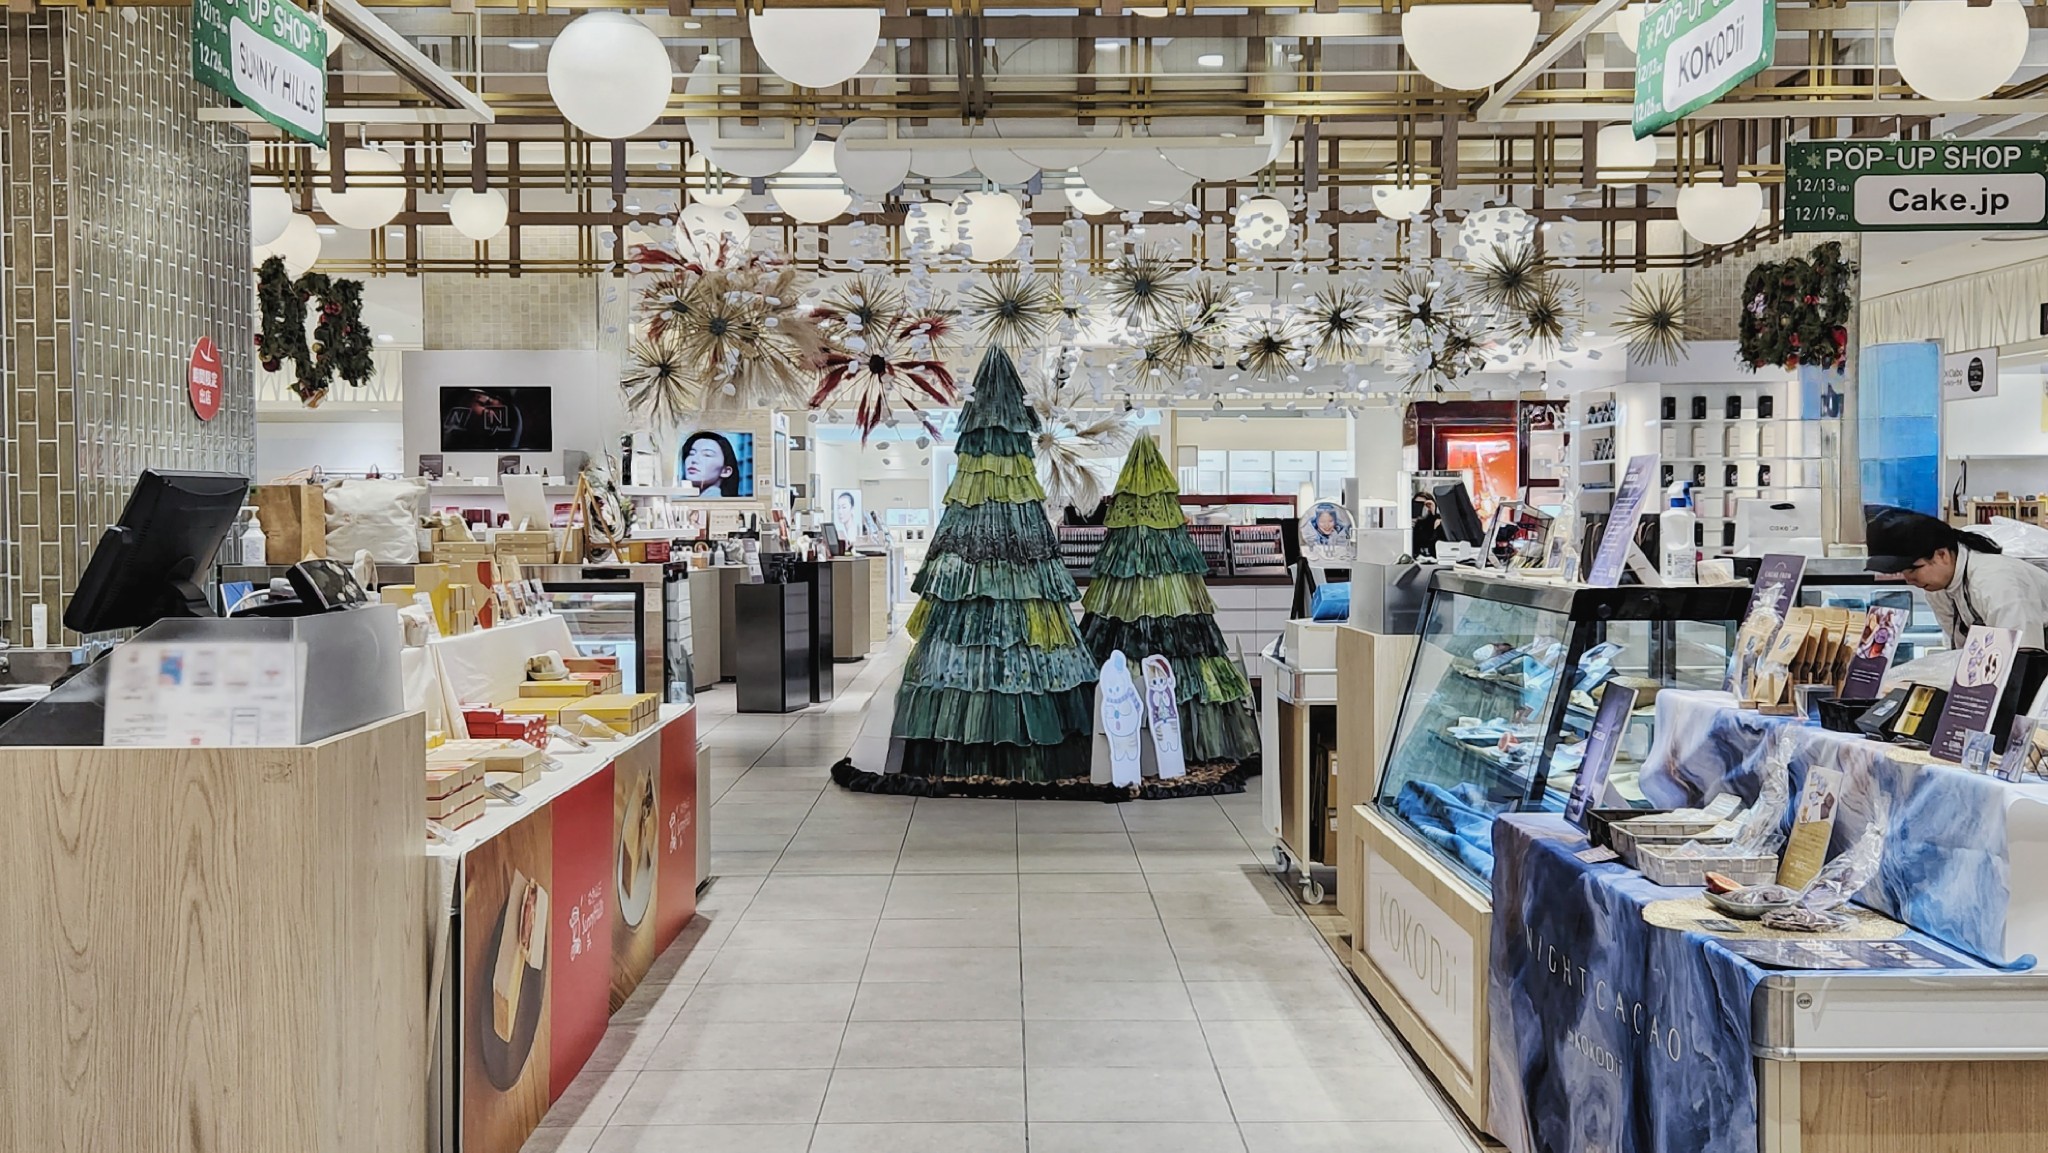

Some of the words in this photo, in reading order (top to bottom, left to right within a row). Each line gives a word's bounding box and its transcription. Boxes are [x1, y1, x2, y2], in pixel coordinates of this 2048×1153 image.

[273, 5, 311, 52] SHOP
[239, 41, 278, 94] SUNNY
[282, 69, 316, 114] HILLS
[1825, 147, 1936, 170] POP-UP
[1944, 145, 2022, 169] SHOP
[1888, 187, 2010, 216] Cake.jp
[1379, 885, 1457, 1016] KOKODii
